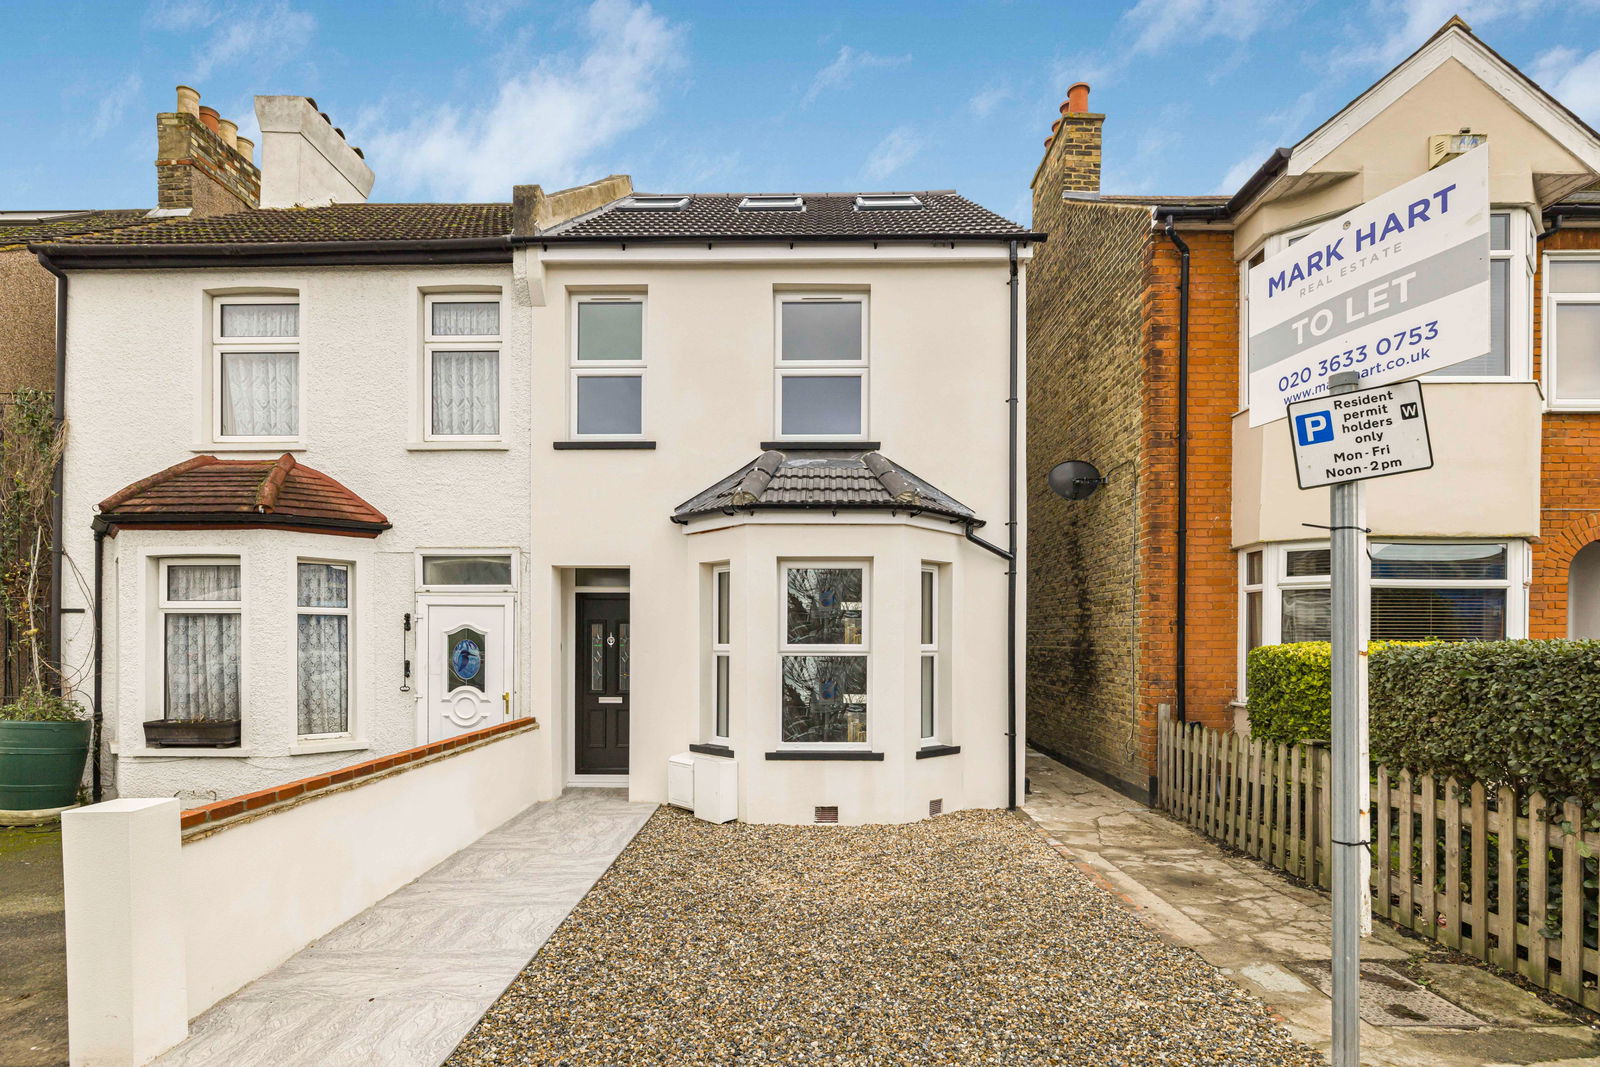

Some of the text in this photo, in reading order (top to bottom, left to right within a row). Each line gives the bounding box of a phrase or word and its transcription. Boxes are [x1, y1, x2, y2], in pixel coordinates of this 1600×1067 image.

[1268, 183, 1457, 299] MARK HART
[1299, 241, 1403, 299] REAL ESTATE
[1291, 271, 1417, 345] TO LET
[1278, 320, 1439, 392] 020 3633 0753
[1333, 390, 1394, 410] Resident
[1343, 404, 1388, 422] permit
[1401, 404, 1417, 418] W
[1304, 415, 1327, 443] P
[1342, 417, 1393, 434] holders
[1355, 431, 1384, 444] only
[1333, 451, 1363, 463] Mon
[1372, 444, 1391, 456] Fri
[1325, 466, 1362, 479] Noon
